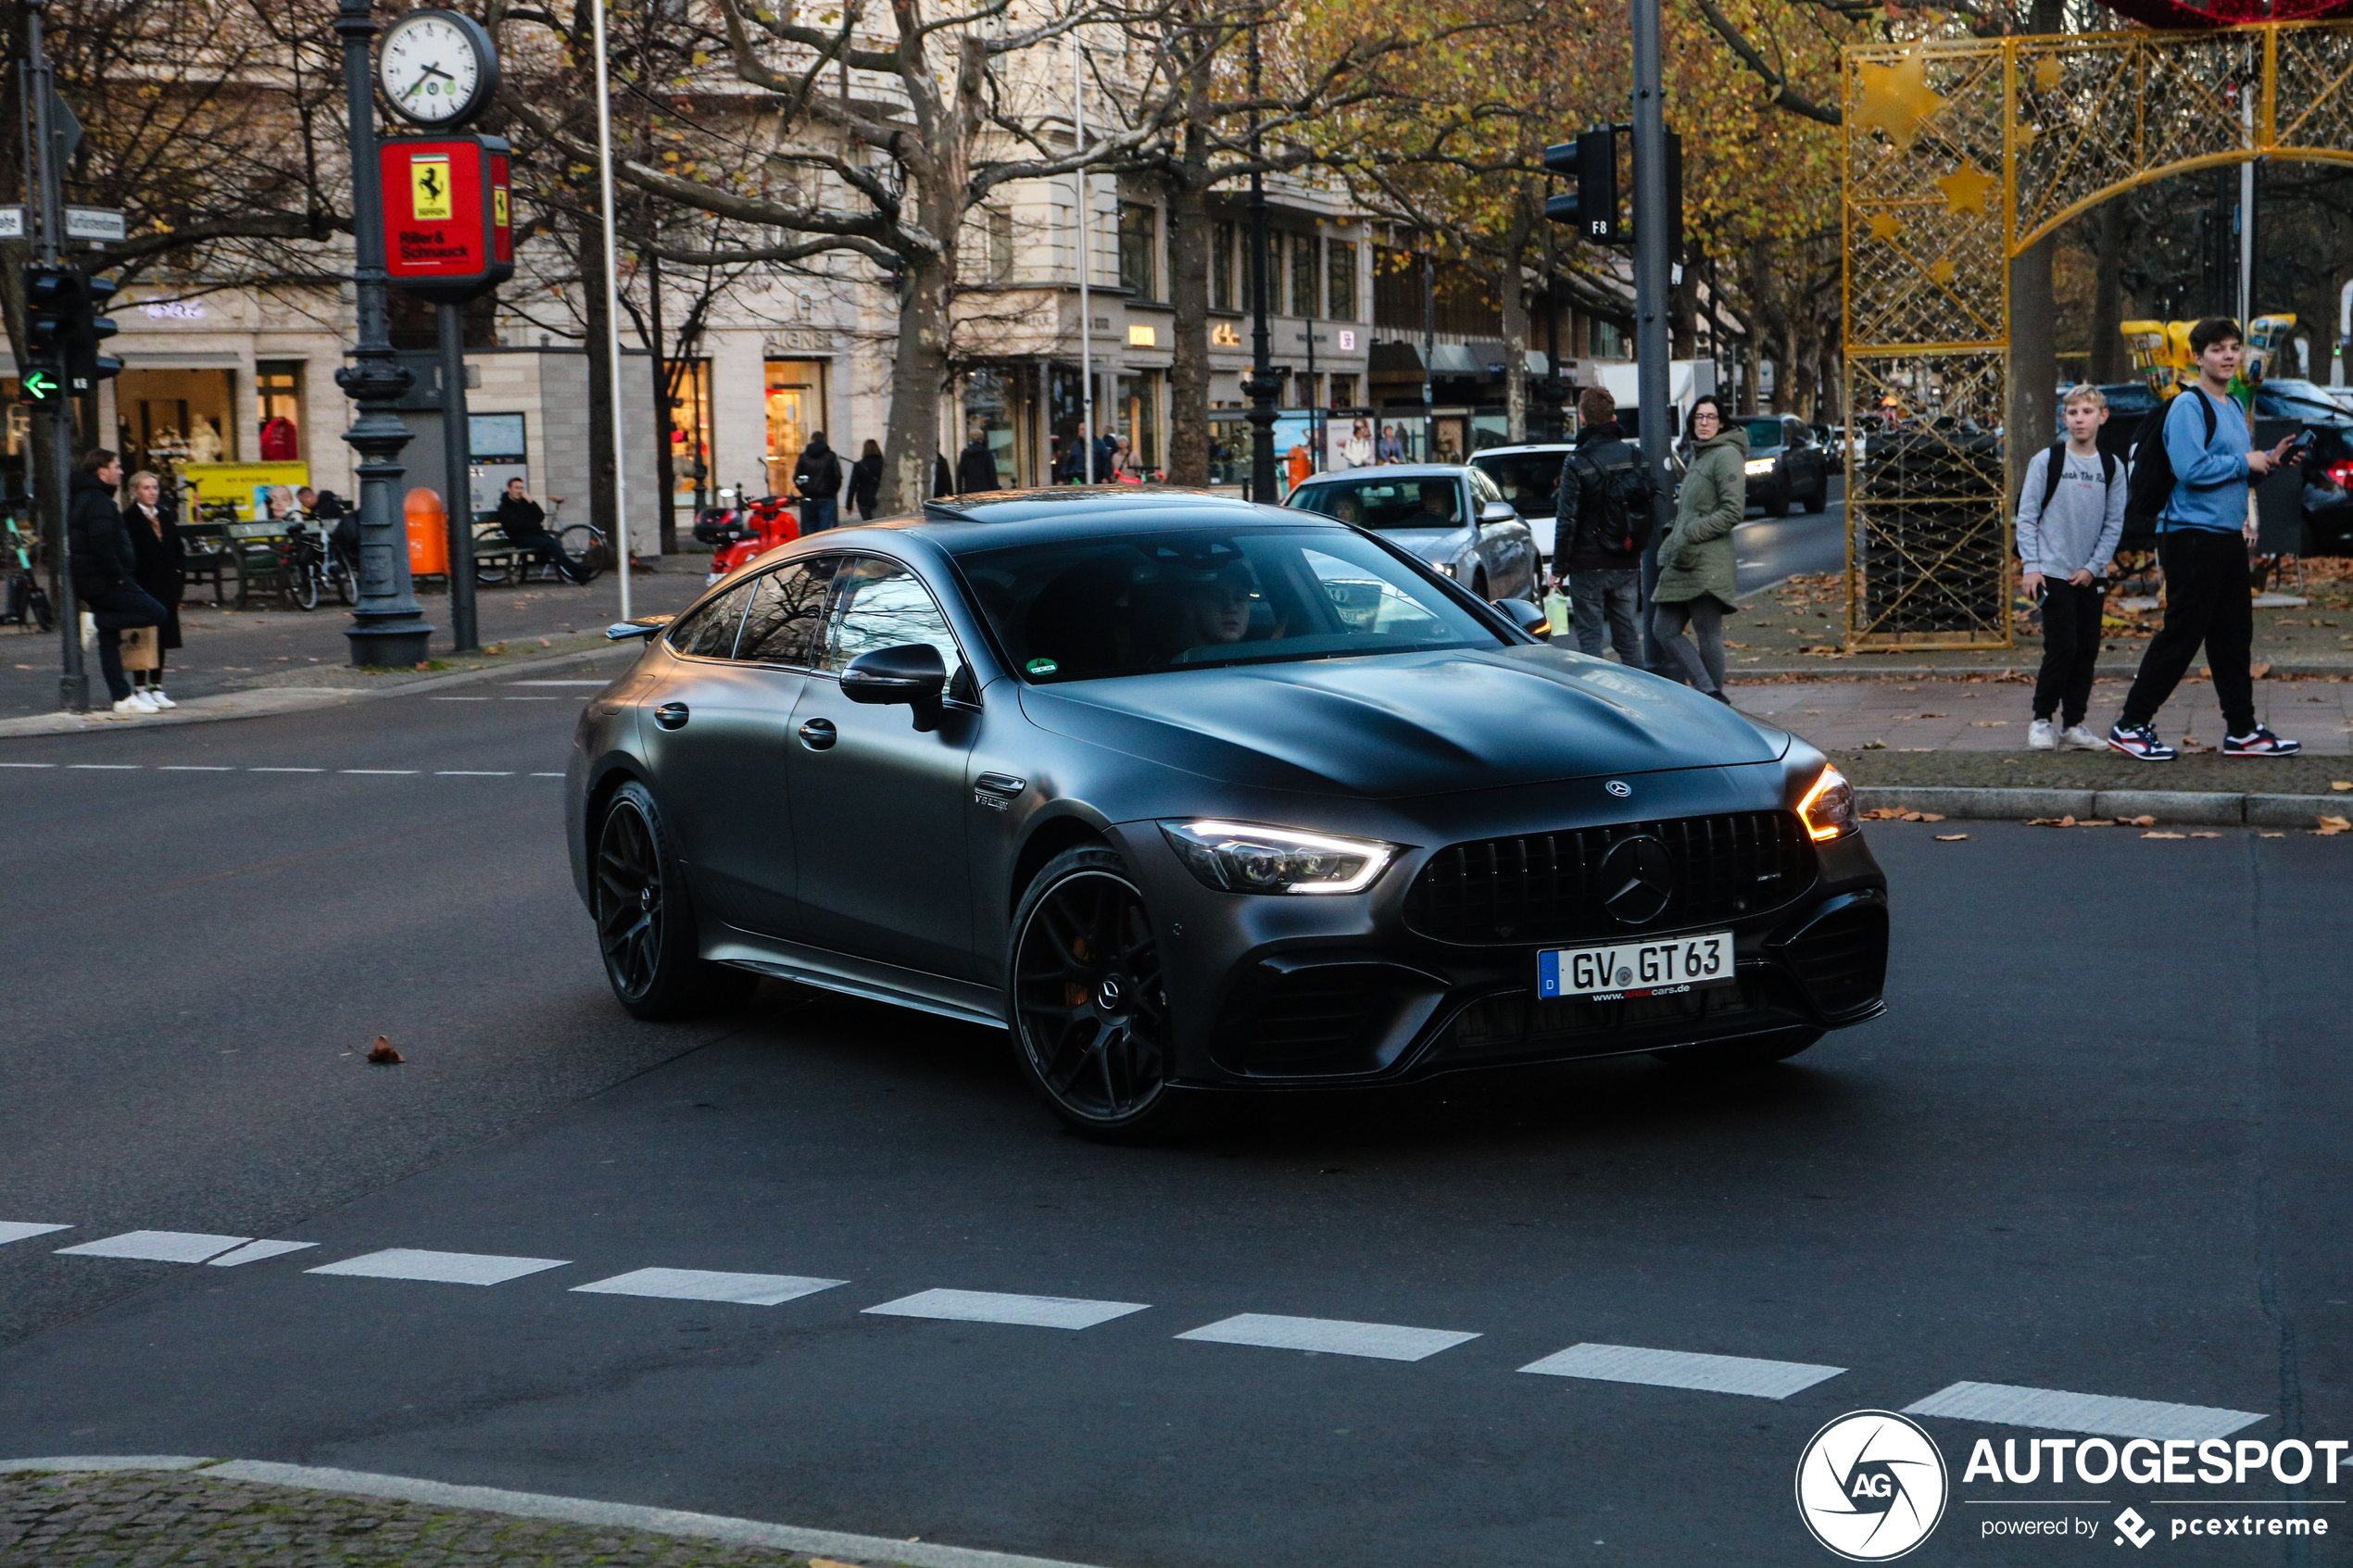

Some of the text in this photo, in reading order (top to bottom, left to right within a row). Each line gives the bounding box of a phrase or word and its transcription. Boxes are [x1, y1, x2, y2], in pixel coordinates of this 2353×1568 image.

[1592, 220, 1607, 234] F8
[435, 231, 445, 244] &
[400, 245, 469, 259] Schnauck
[764, 331, 833, 350] AIGNER
[2081, 471, 2094, 482] The
[1573, 939, 1720, 989] GV GT 63
[1546, 979, 1554, 990] D
[1592, 984, 1691, 1002] www.AREAcars.de
